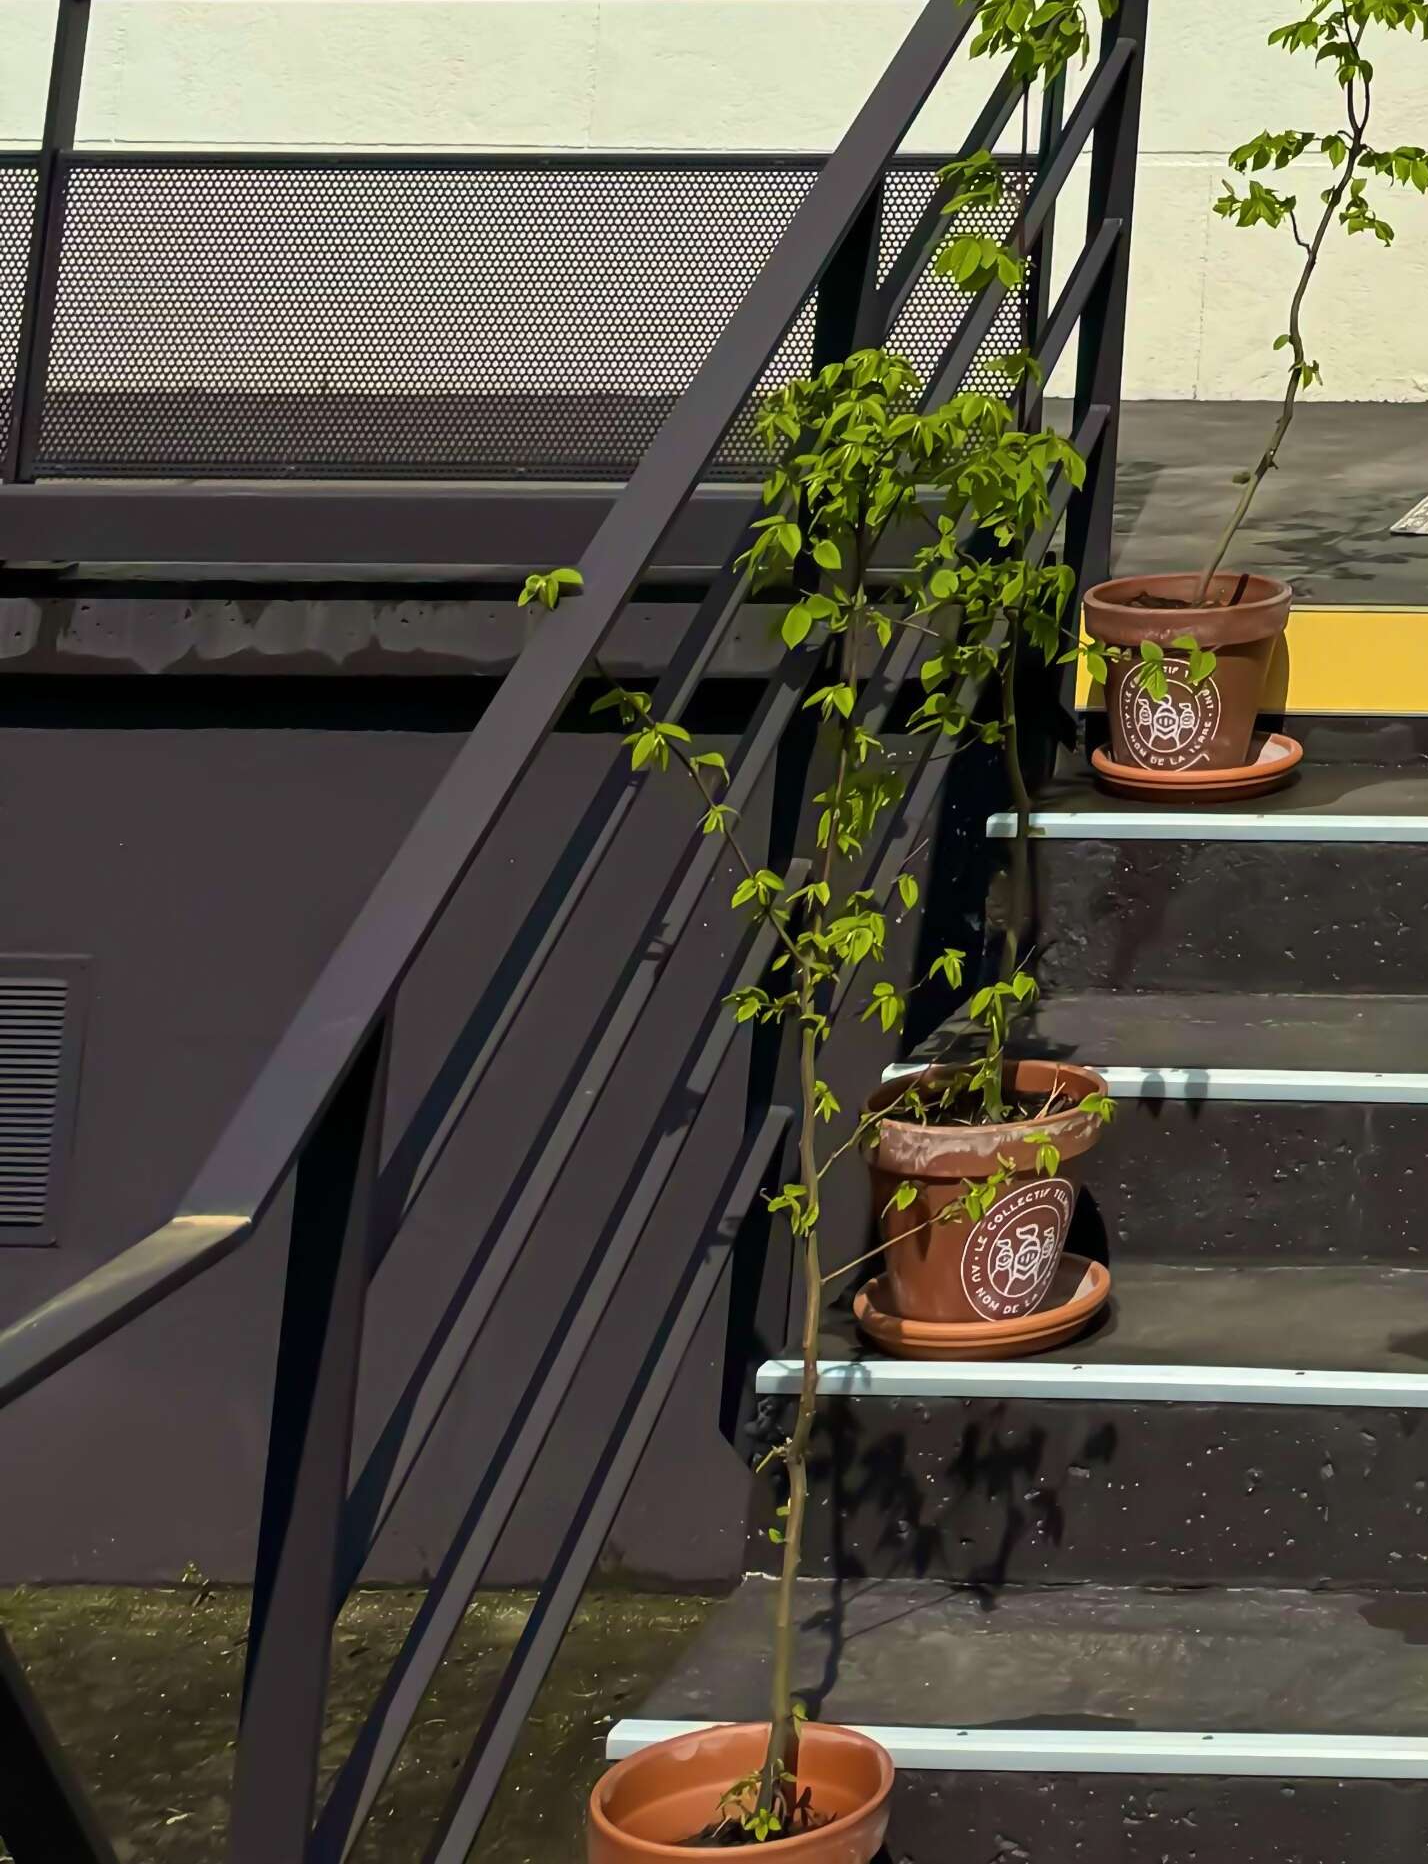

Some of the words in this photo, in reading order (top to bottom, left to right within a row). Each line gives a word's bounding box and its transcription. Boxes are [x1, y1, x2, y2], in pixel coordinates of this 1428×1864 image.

[974, 1235, 988, 1252] LE
[987, 1187, 1051, 1231] COLLECTIF
[971, 1265, 981, 1283] AU
[975, 1286, 1000, 1311] NOM
[1002, 1304, 1020, 1314] DE
